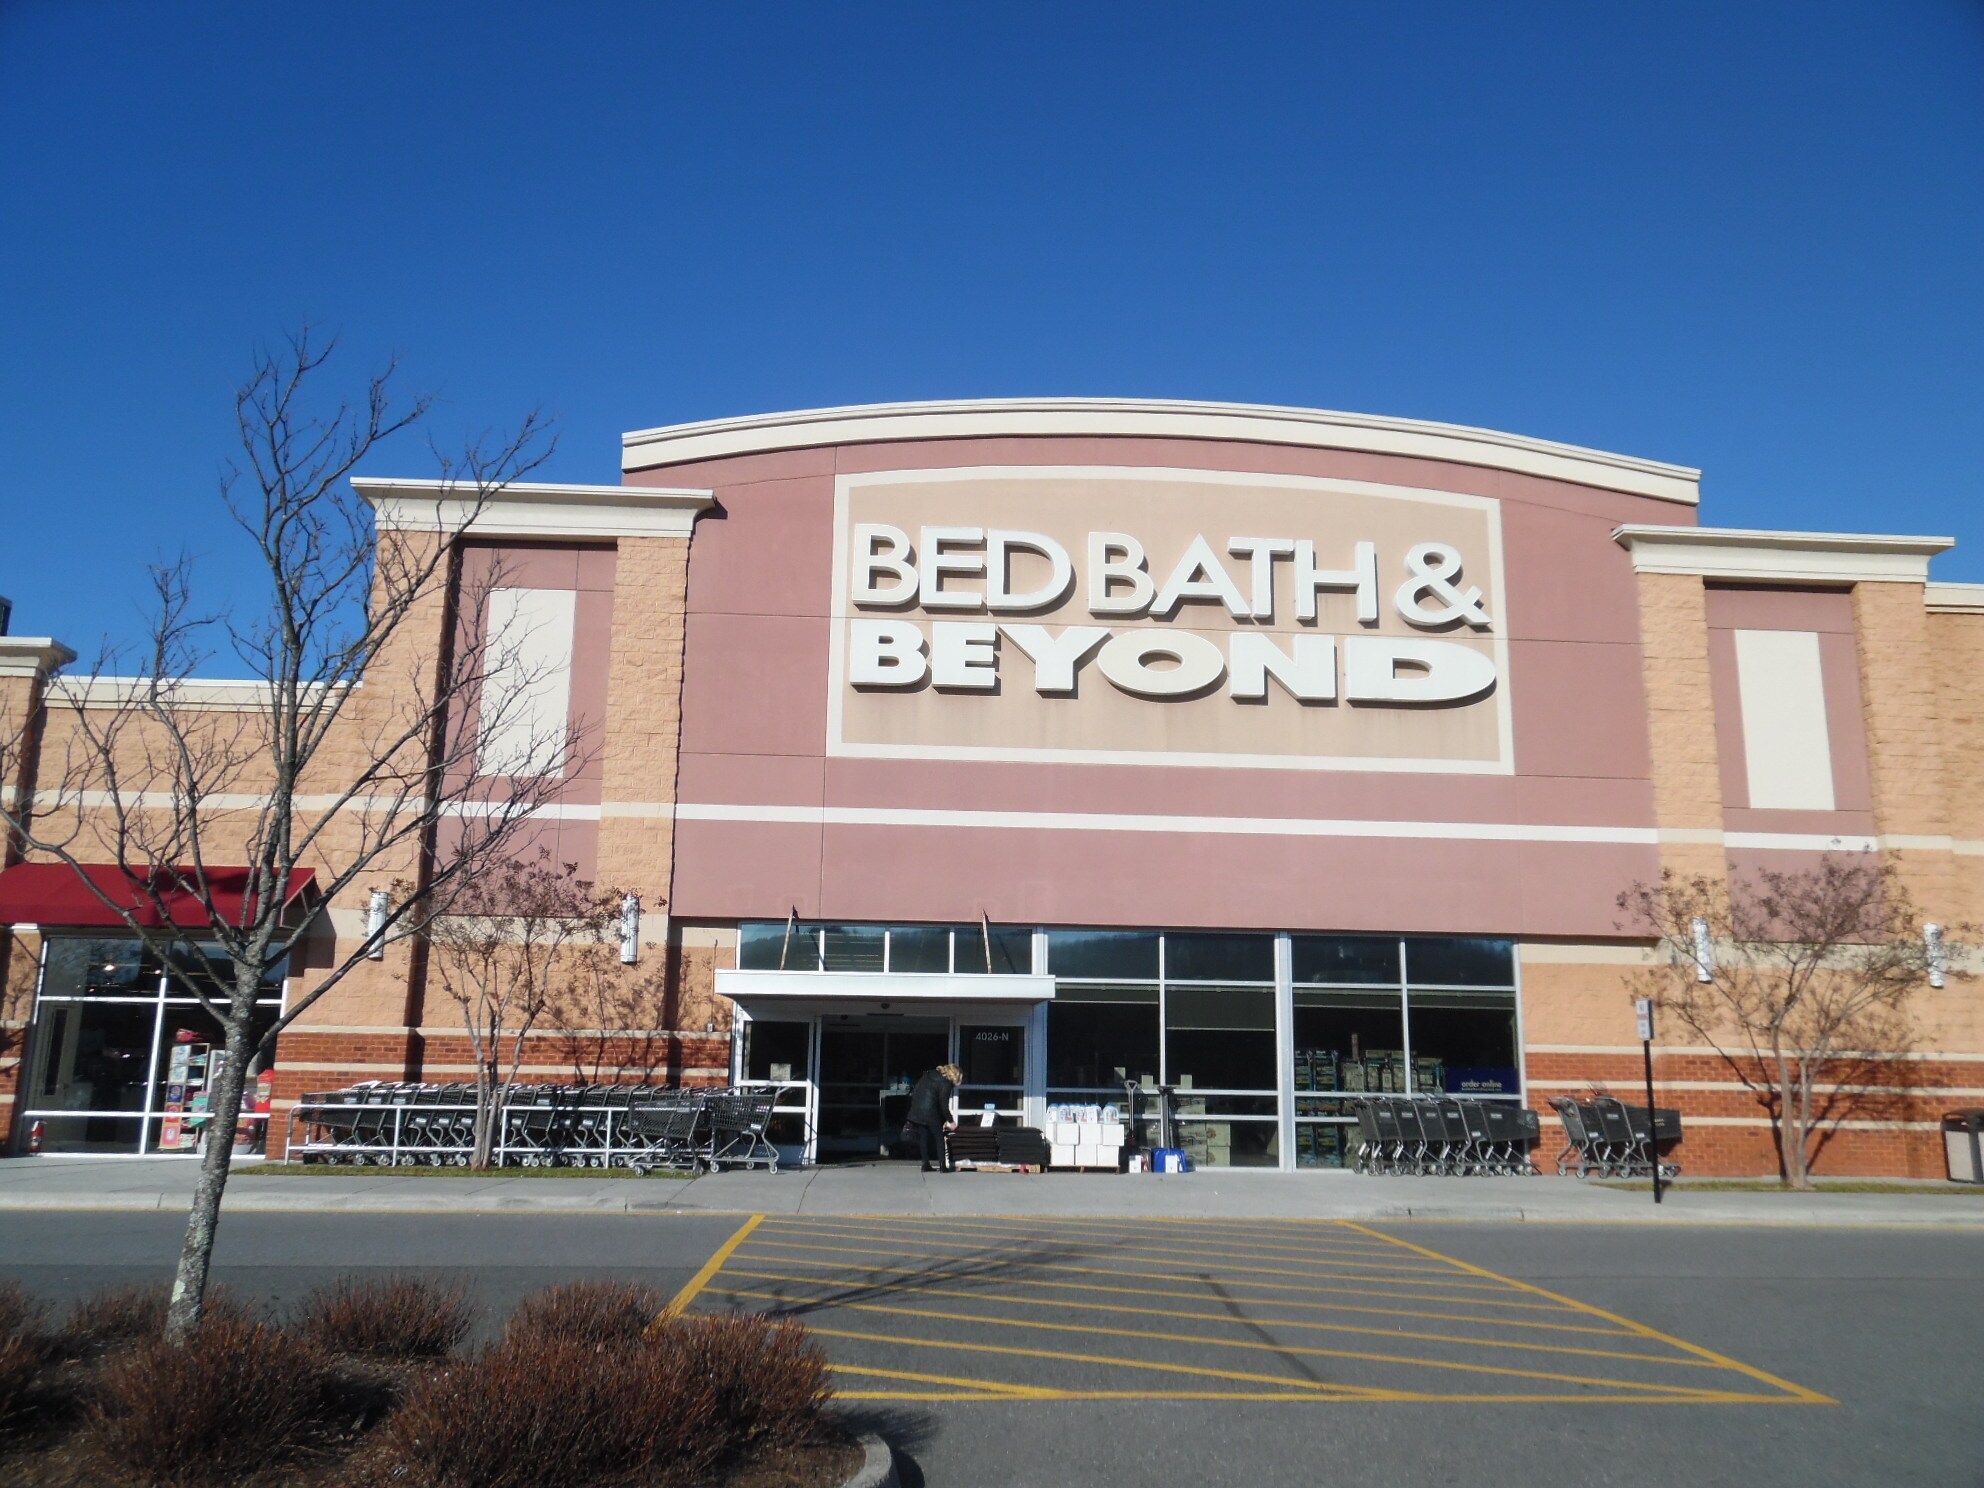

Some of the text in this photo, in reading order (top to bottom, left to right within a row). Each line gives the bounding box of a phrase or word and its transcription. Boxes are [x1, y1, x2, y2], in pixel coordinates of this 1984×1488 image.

[852, 523, 1493, 627] BED BATH &
[849, 619, 1497, 702] BEYOND
[1461, 1079, 1502, 1088] order online
